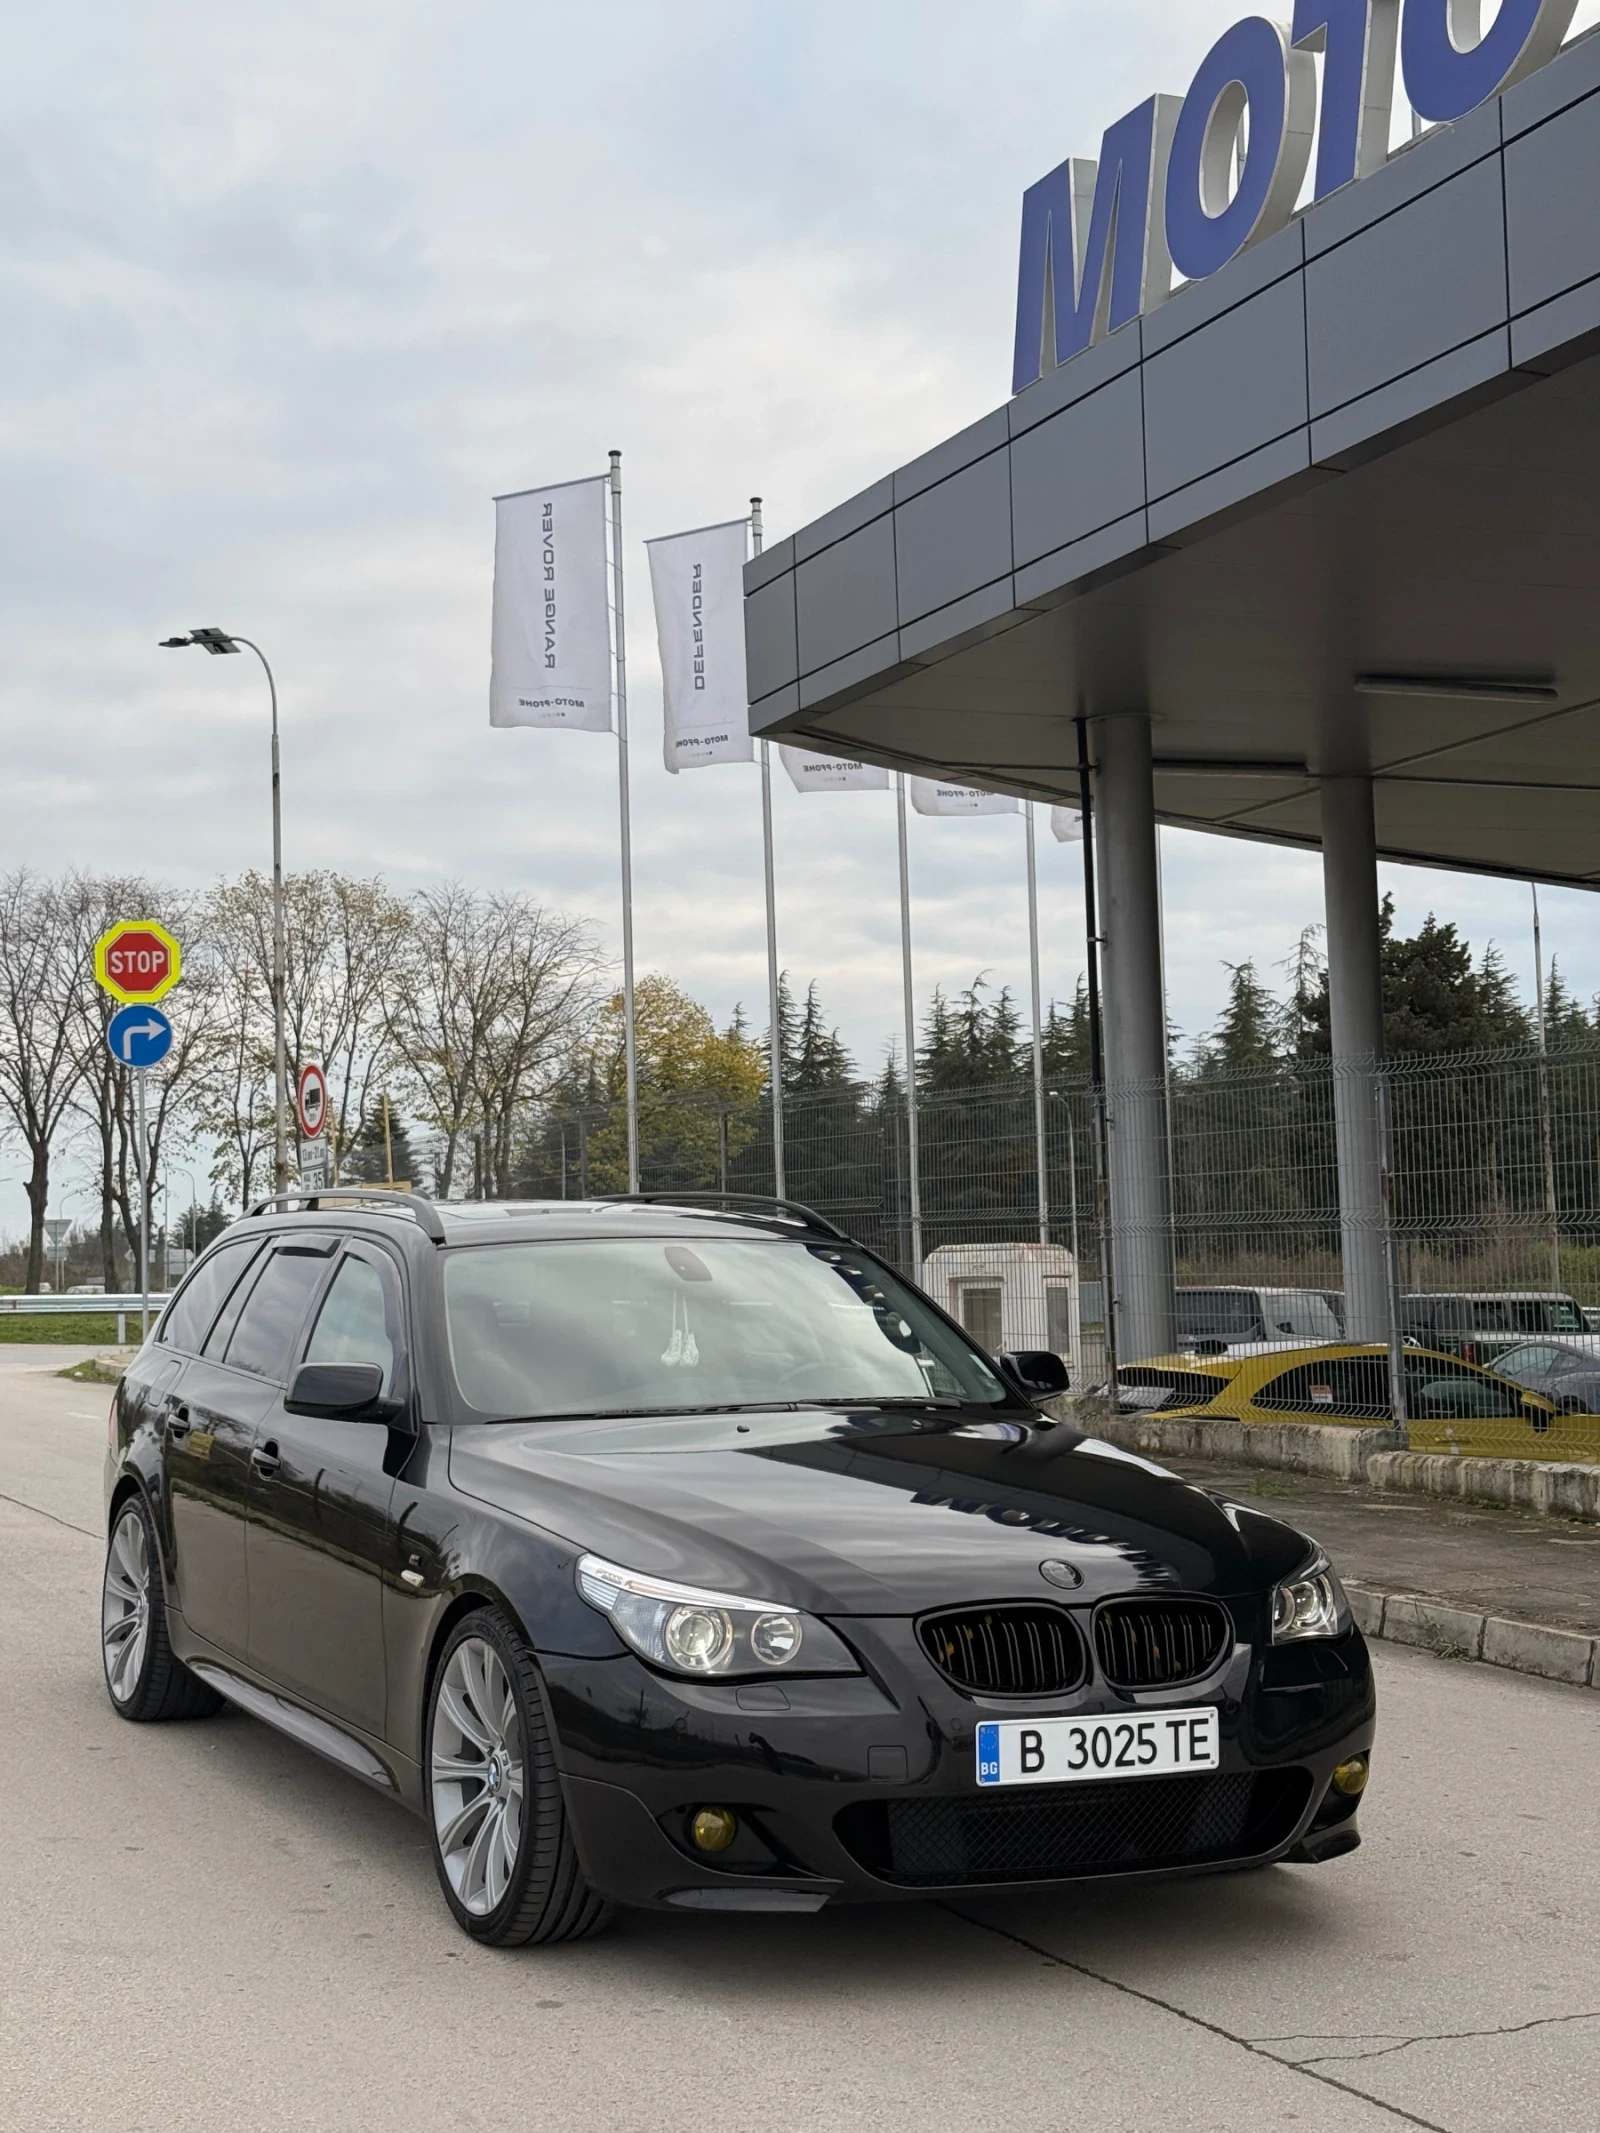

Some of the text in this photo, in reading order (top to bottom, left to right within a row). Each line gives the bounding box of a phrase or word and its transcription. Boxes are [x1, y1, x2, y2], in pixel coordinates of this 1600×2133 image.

[111, 950, 165, 974] STOP
[313, 1171, 323, 1190] 35
[1020, 1718, 1211, 1773] B 3025 TE
[981, 1761, 998, 1776] BG
